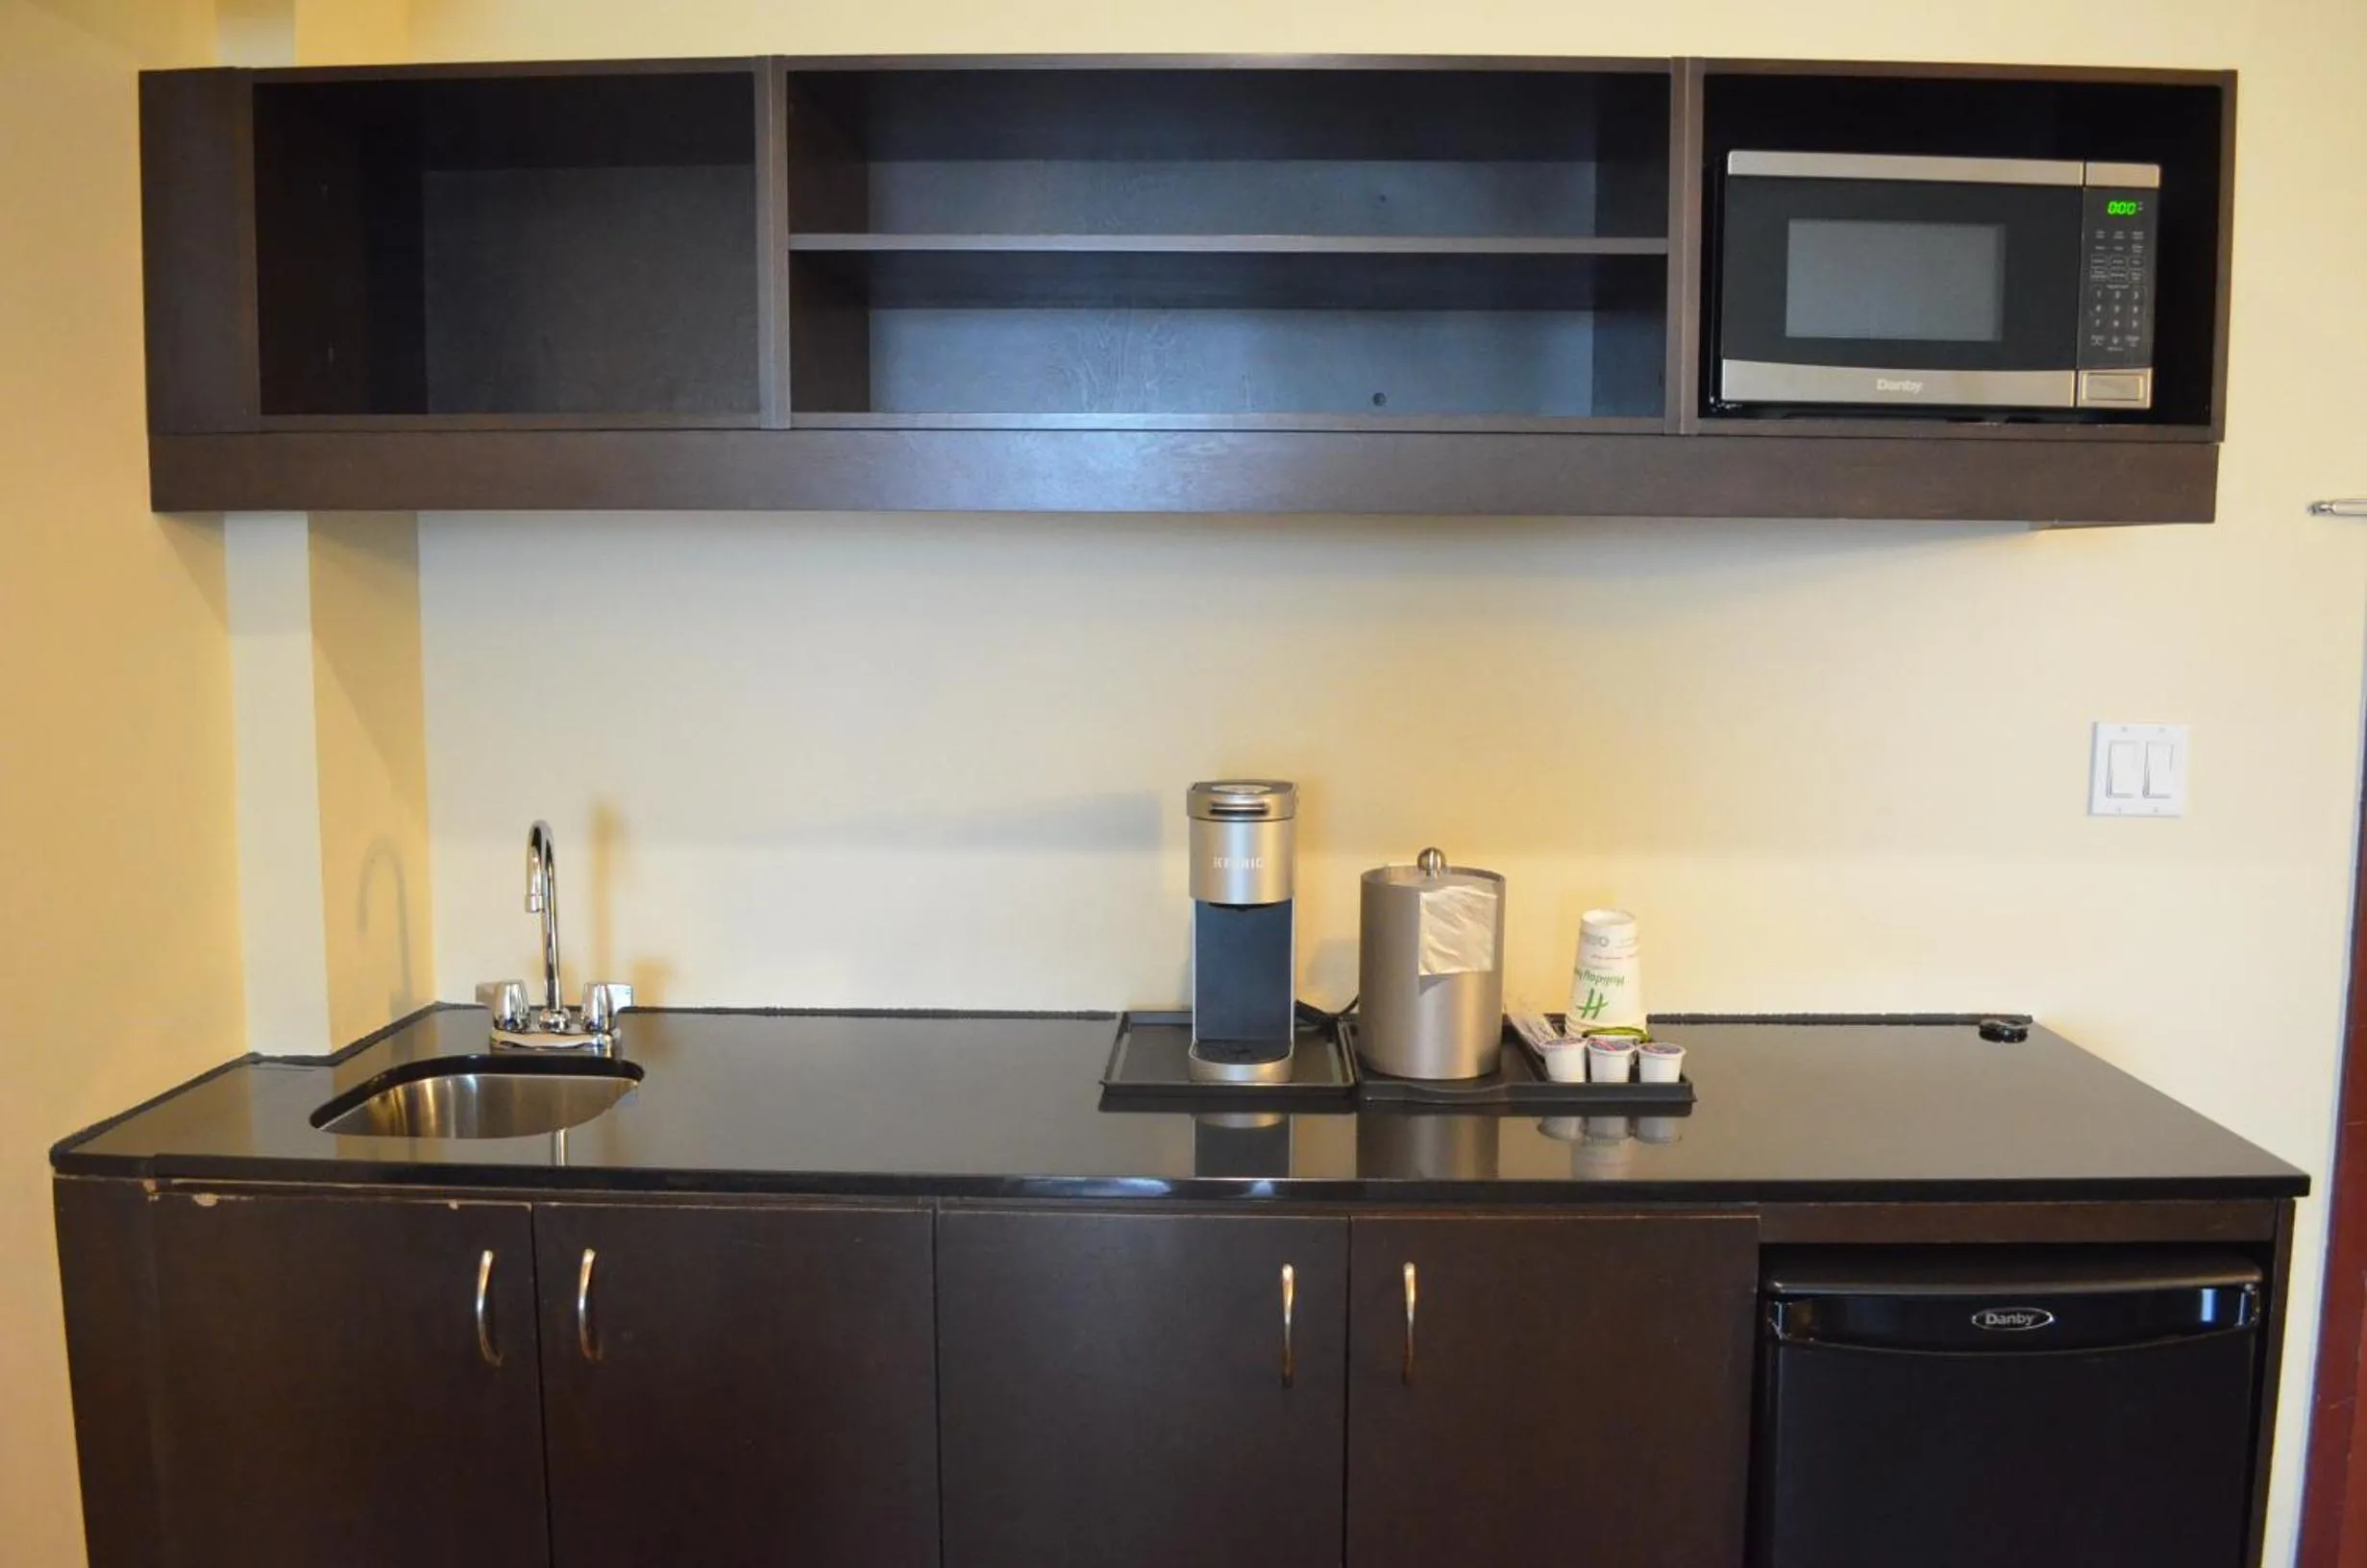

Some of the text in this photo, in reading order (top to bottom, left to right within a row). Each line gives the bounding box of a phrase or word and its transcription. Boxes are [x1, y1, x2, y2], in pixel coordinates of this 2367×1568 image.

[1877, 379, 1922, 395] Danby
[1213, 857, 1264, 869] KERIG
[1985, 1312, 2034, 1326] Danby
